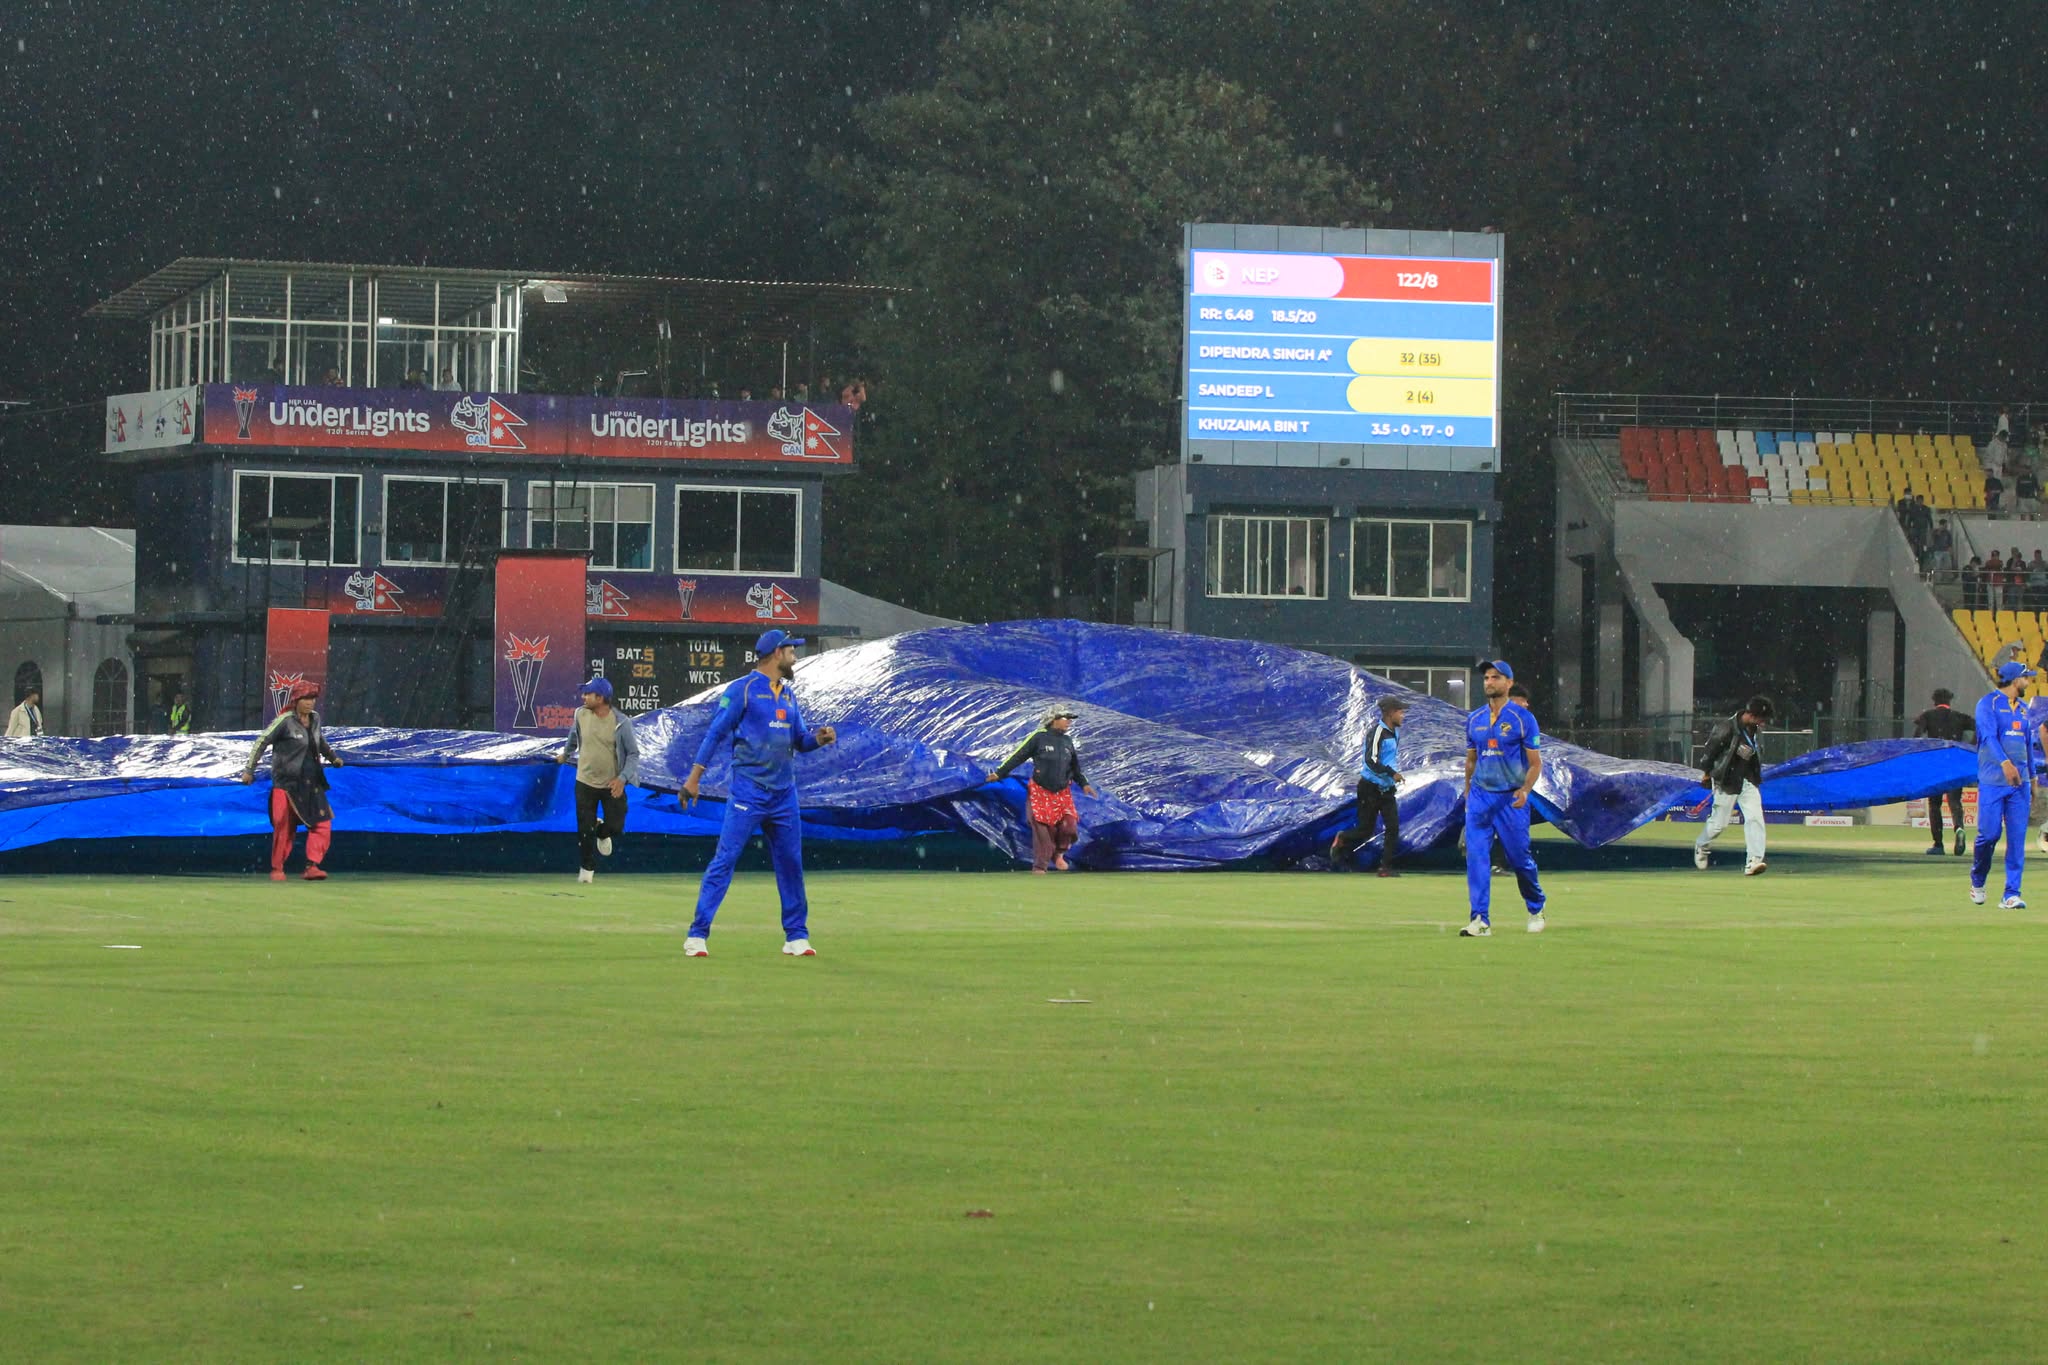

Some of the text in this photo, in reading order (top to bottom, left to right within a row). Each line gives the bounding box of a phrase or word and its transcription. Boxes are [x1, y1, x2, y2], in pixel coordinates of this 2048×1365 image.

[1242, 267, 1279, 283] NEP
[1397, 272, 1438, 289] 122/8
[1200, 308, 1316, 323] RR: 6.48 18.5/20
[1200, 346, 1271, 360] DIPENDRA
[1273, 348, 1314, 361] SINGH
[1400, 352, 1441, 366] 32 (35)
[1199, 384, 1275, 398] SANDEEP L
[1407, 391, 1434, 404] 2 (4)
[1199, 418, 1310, 433] KHUZAIMA BIN T
[1371, 423, 1391, 435] 3.5
[1401, 424, 1411, 436] 0
[1420, 425, 1435, 436] 17
[1444, 425, 1454, 437] 0
[467, 434, 487, 444] CAN
[782, 445, 802, 454] CAN
[688, 639, 723, 652] TOTAL
[616, 648, 644, 660] BAT.
[689, 654, 724, 667] 122
[745, 651, 759, 663] BA
[633, 664, 654, 678] 32
[689, 671, 721, 684] WKTS
[629, 685, 659, 698] D/L/S
[618, 698, 660, 710] TARGET
